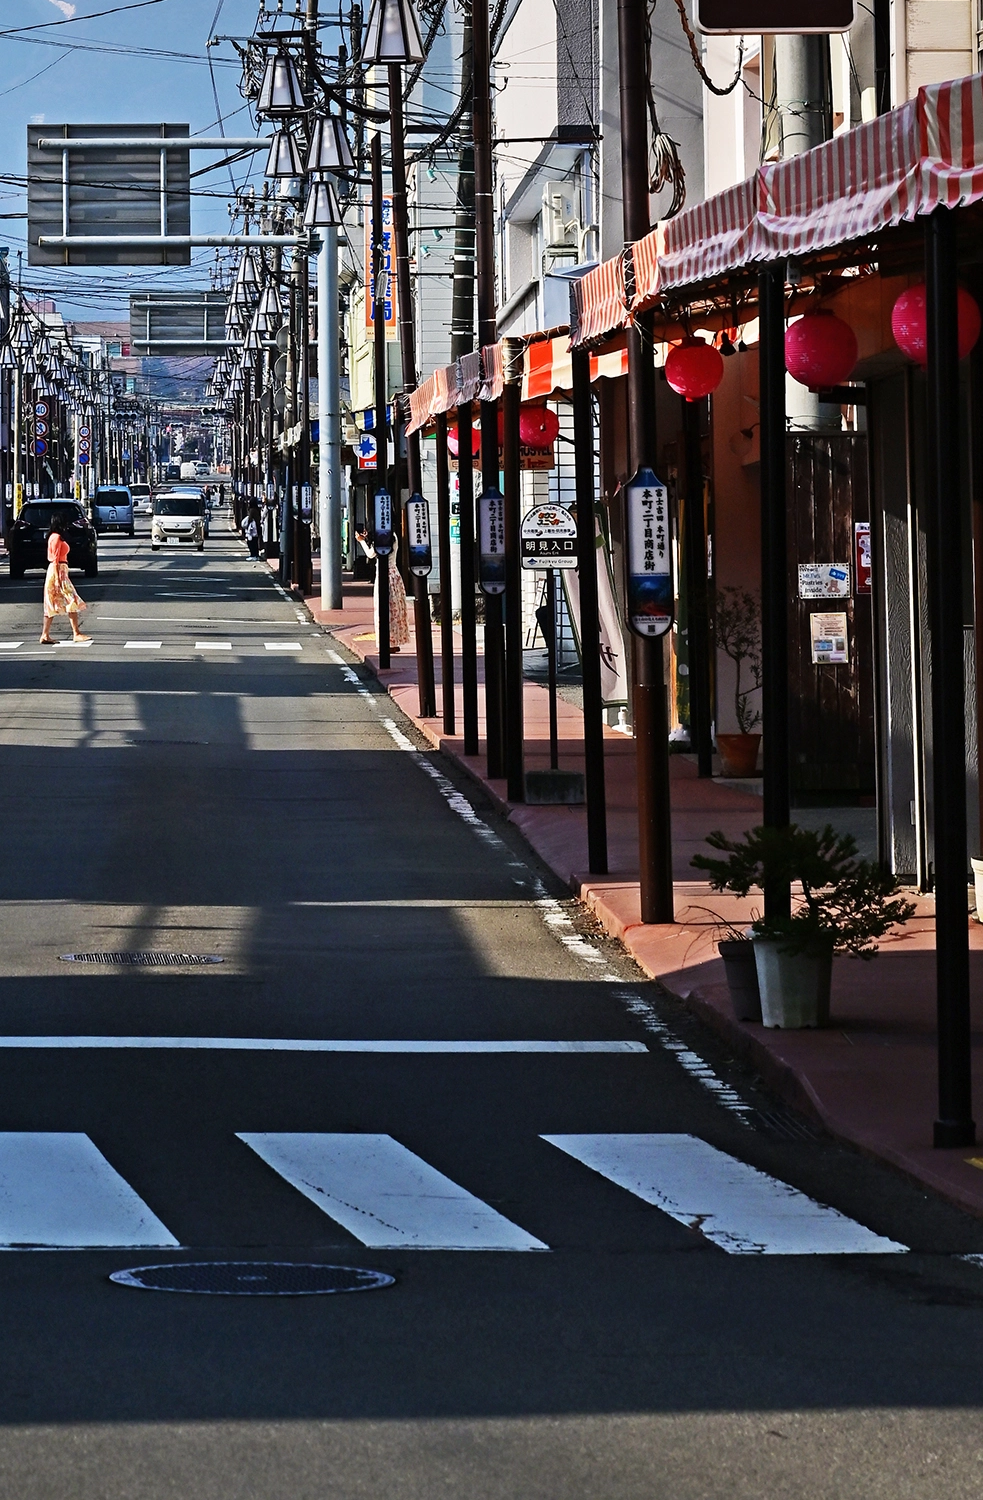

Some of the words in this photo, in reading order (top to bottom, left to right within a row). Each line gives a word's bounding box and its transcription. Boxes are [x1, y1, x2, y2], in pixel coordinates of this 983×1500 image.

[655, 488, 664, 522] 富士吉田
[525, 540, 574, 551] 明見入口
[641, 488, 655, 572] 本町二丁目商店街
[656, 524, 665, 559] 本町通り
